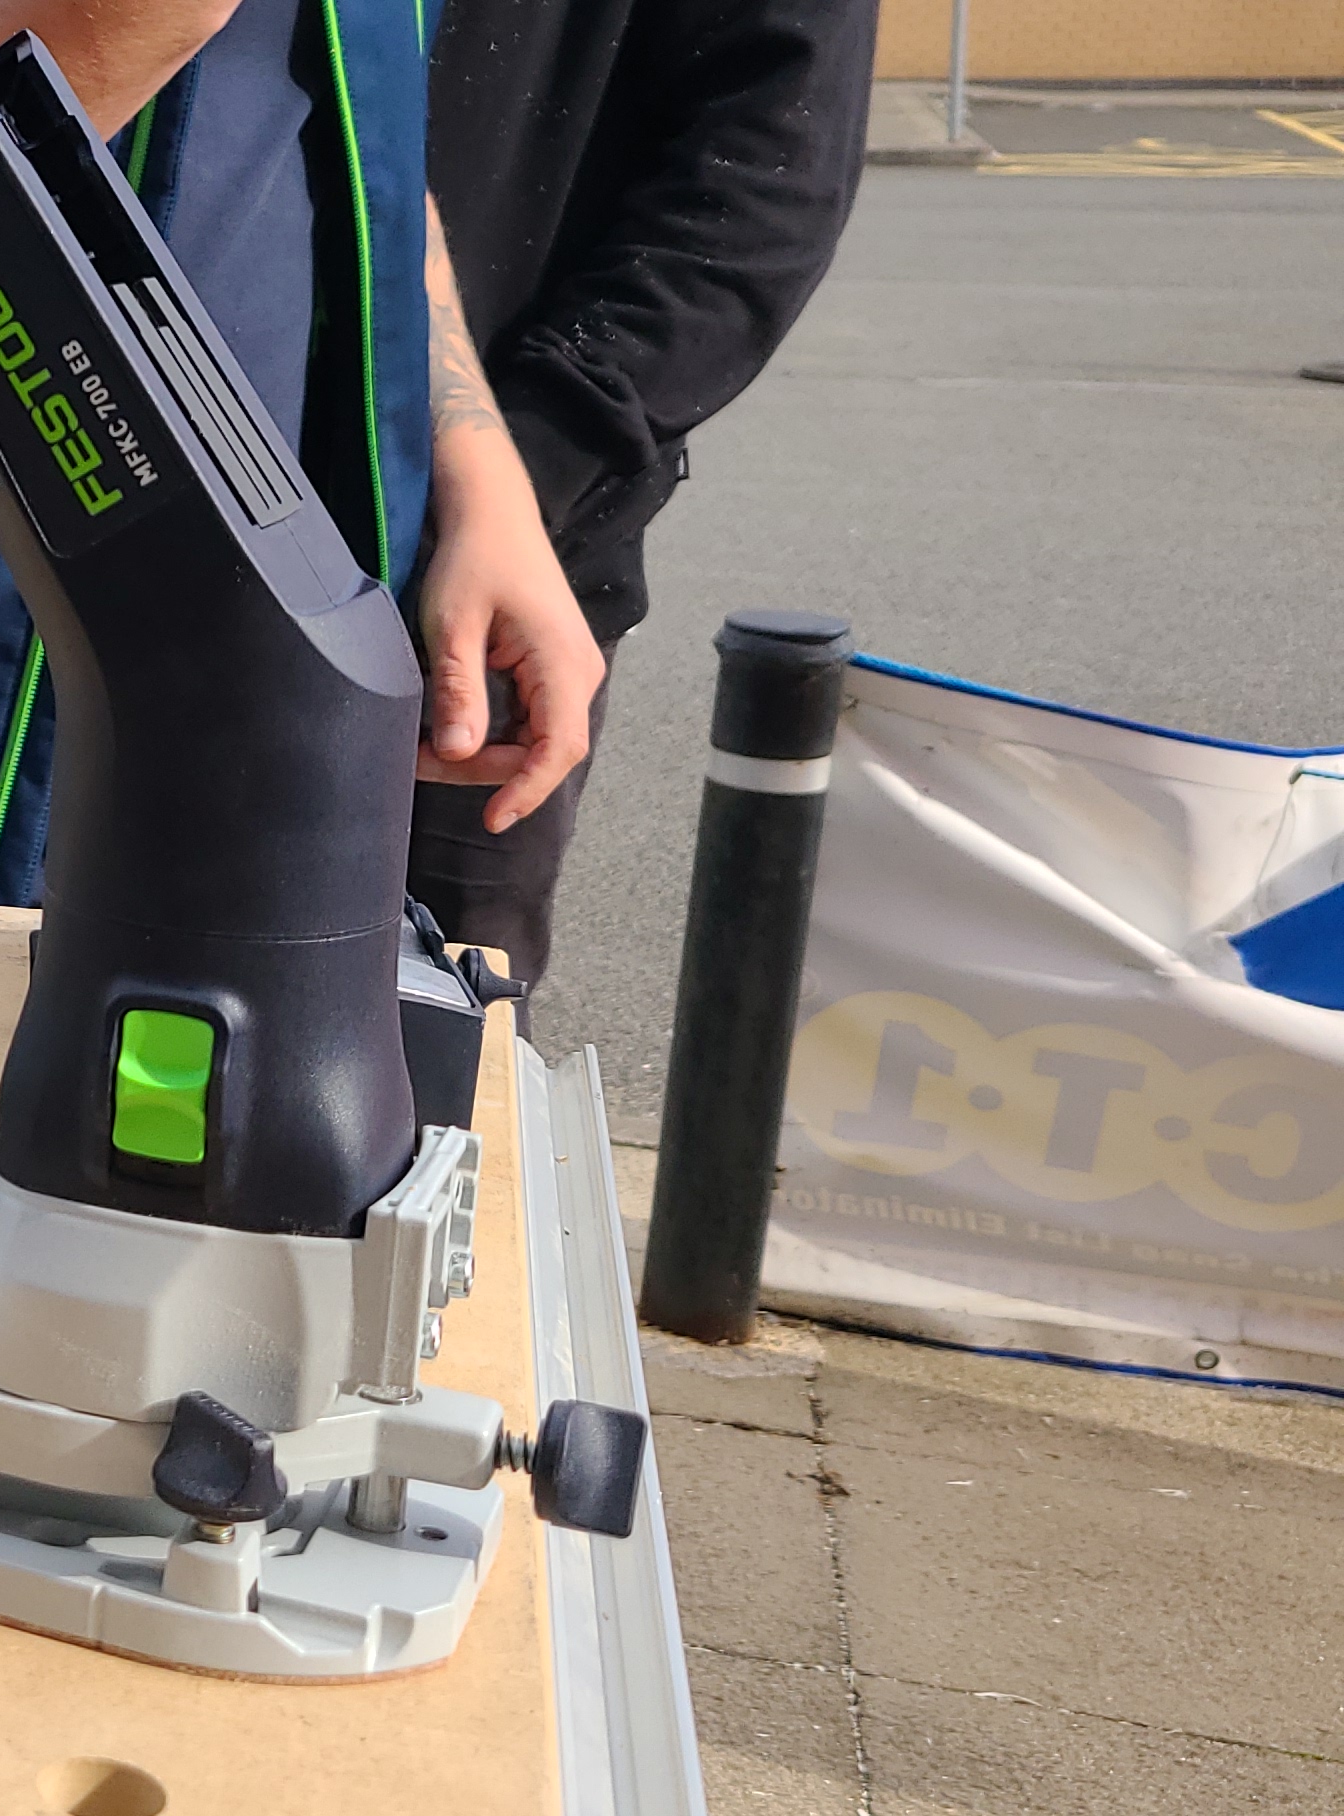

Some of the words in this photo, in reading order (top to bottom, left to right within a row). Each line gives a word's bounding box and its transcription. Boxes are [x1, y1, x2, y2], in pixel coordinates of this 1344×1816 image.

[61, 339, 91, 375] EB
[81, 374, 118, 421] 700
[108, 418, 158, 486] MFKC
